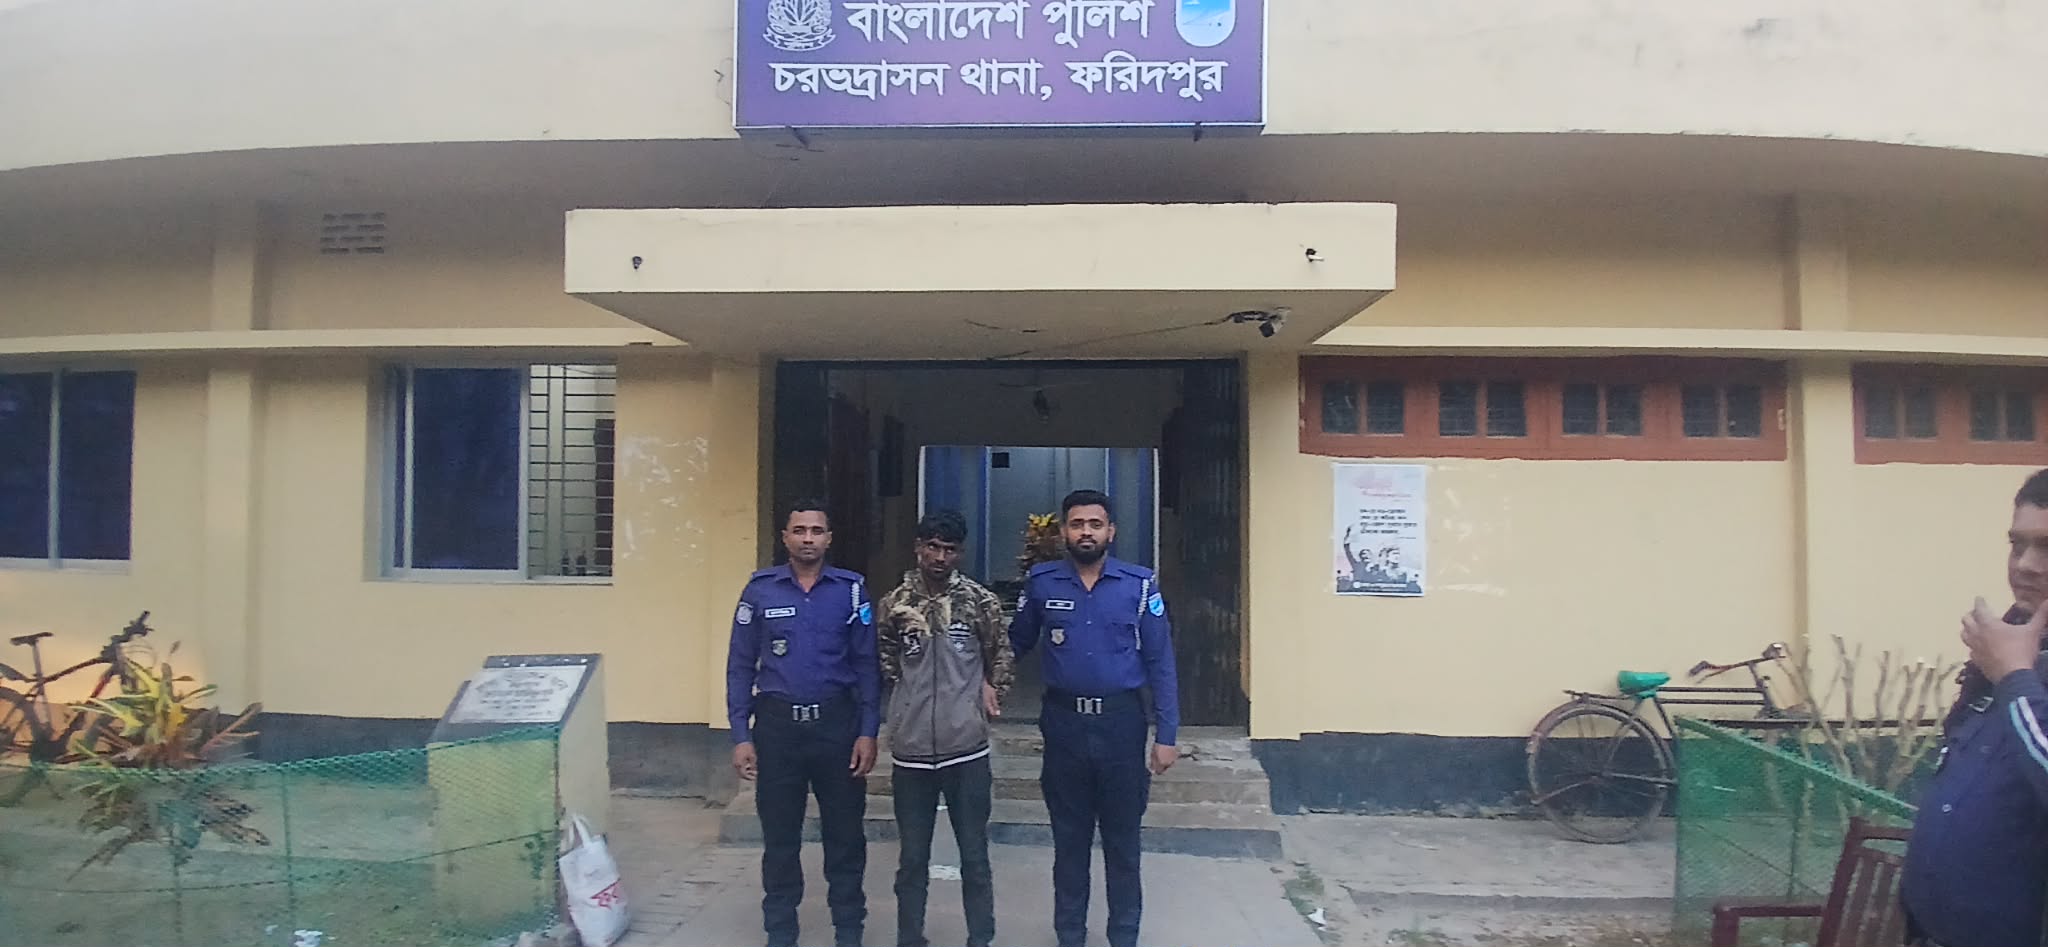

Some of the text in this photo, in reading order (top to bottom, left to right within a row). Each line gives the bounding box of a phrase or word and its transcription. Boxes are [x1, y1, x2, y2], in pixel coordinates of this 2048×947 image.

[843, 0, 1030, 44] বাংলাদেশ
[768, 50, 1229, 101] চরভদ্রাসন থানা, ফরিদপুর
